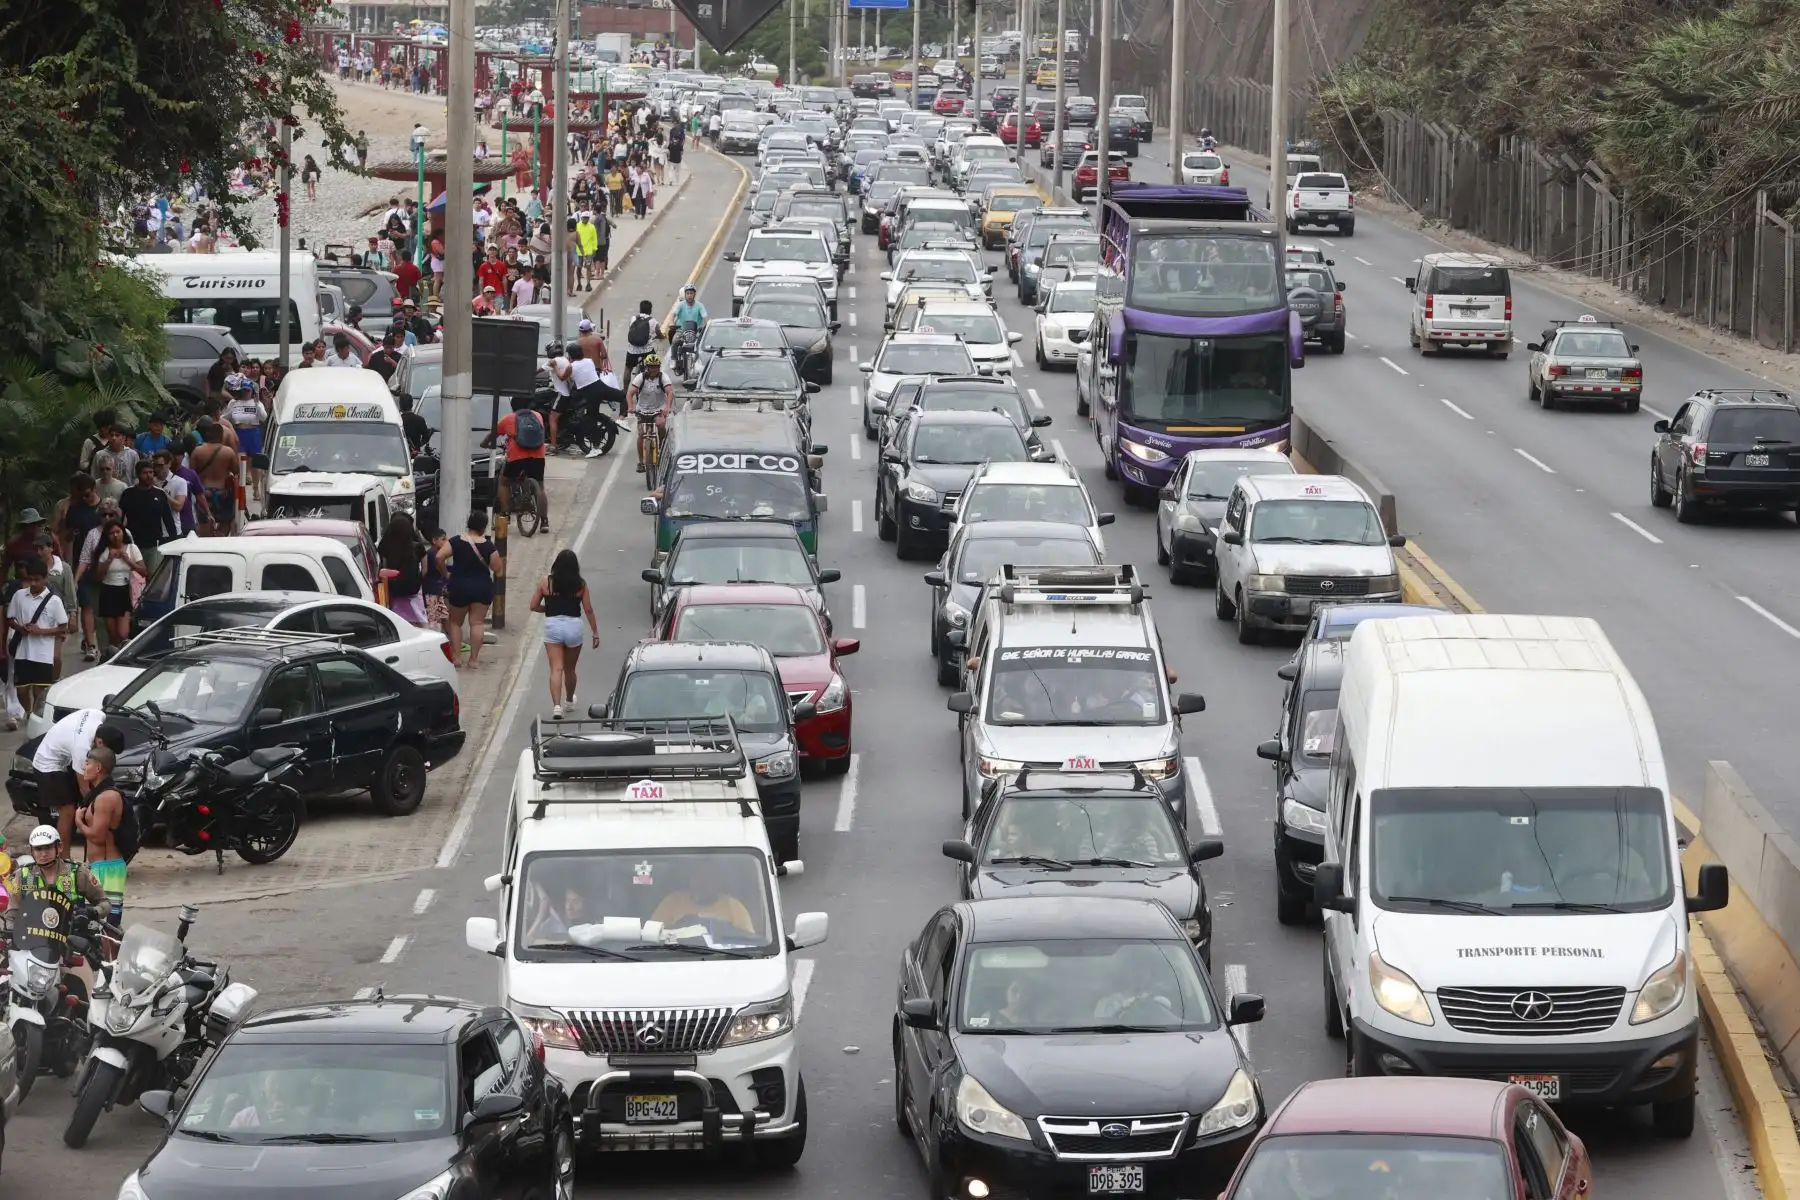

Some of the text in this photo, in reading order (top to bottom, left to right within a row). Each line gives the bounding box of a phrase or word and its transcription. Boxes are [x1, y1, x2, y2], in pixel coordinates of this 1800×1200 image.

[183, 276, 266, 289] Turismo
[1144, 436, 1172, 449] Servicio
[676, 453, 800, 475] sparco
[1304, 487, 1322, 495] TAXI
[1022, 648, 1051, 659] SEÑOR
[1053, 648, 1067, 658] DE
[1115, 650, 1152, 661] GRANDE
[1068, 758, 1095, 769] TAXI
[631, 786, 663, 799] TAXI
[32, 890, 72, 911] POLICIA
[1456, 946, 1605, 959] TRANSPORTE PERSONAL
[627, 1101, 676, 1117] BPG-422
[1091, 1172, 1142, 1190] D9B-395
